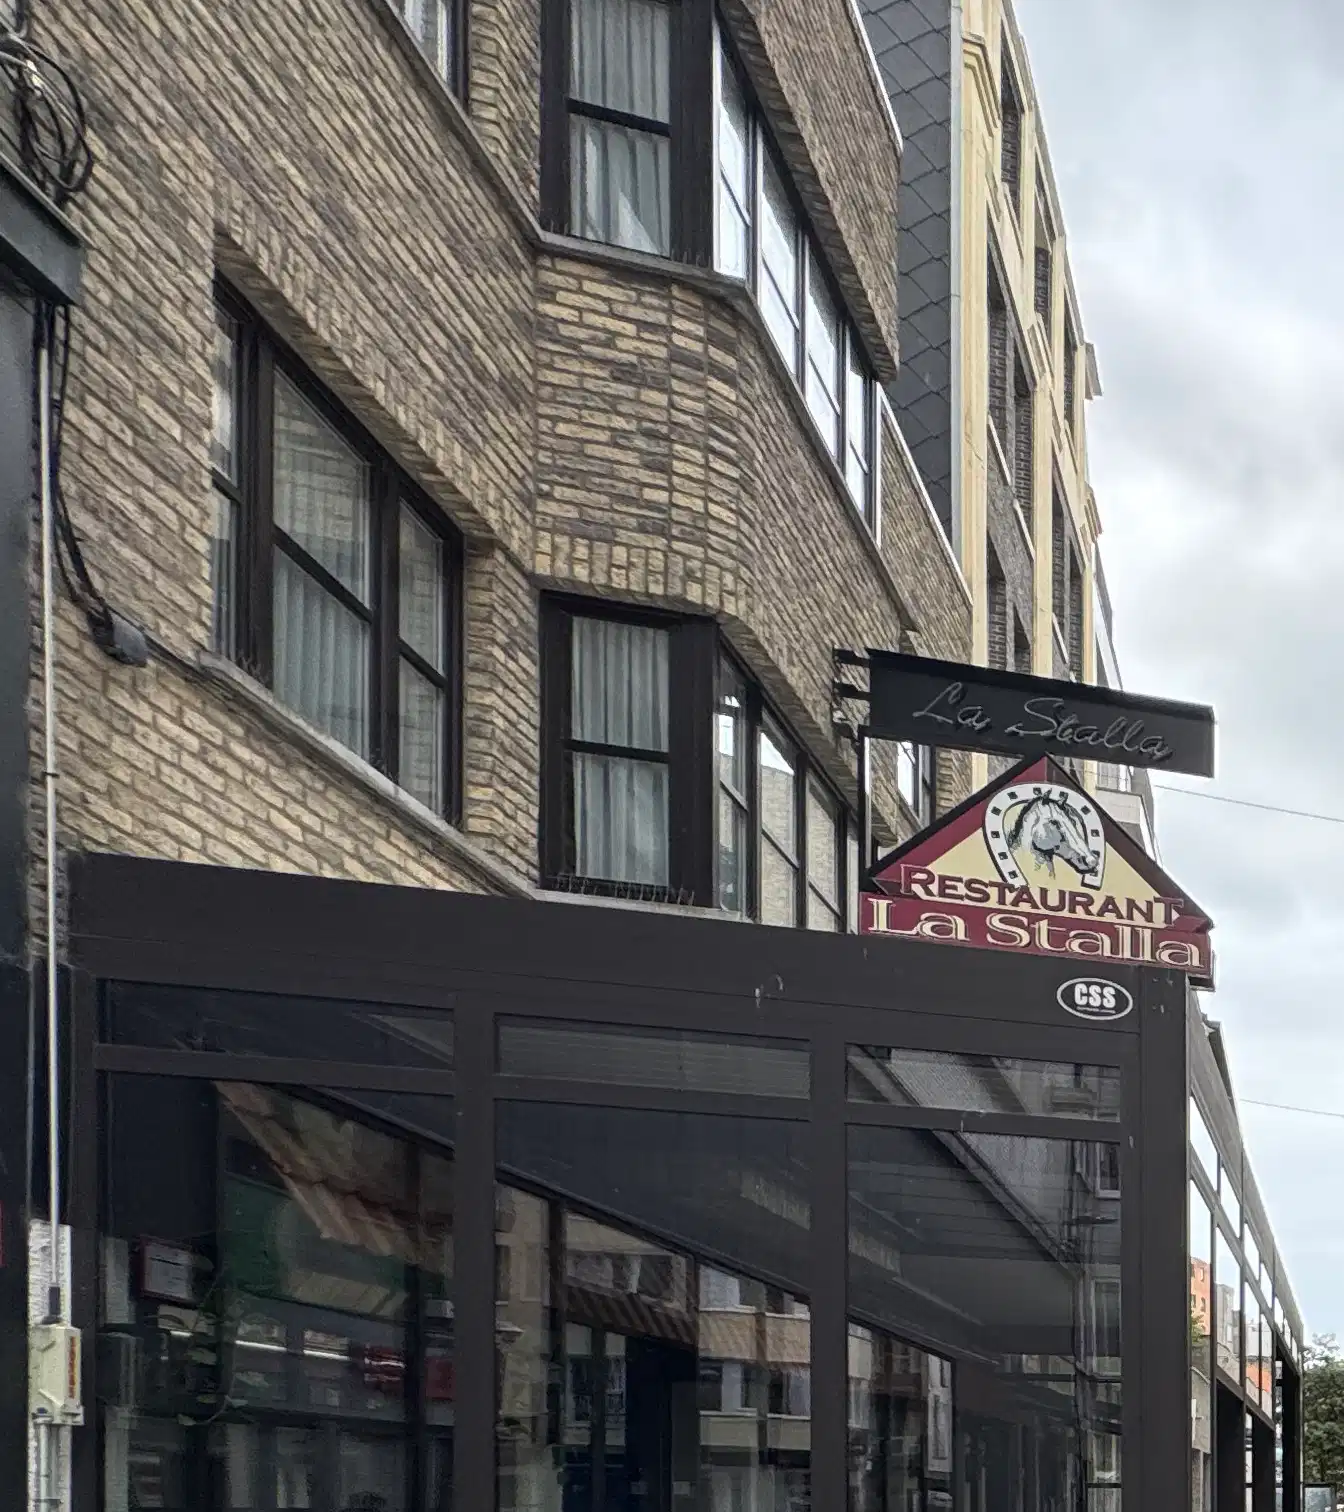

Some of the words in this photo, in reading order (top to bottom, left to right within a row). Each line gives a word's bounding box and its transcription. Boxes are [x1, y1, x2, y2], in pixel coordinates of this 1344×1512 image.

[912, 681, 991, 731] La
[1004, 697, 1174, 762] Stalla
[900, 863, 1184, 929] RESTAURANT
[867, 897, 970, 943] La
[986, 912, 1205, 969] Stalla
[1074, 983, 1116, 1009] CSS
